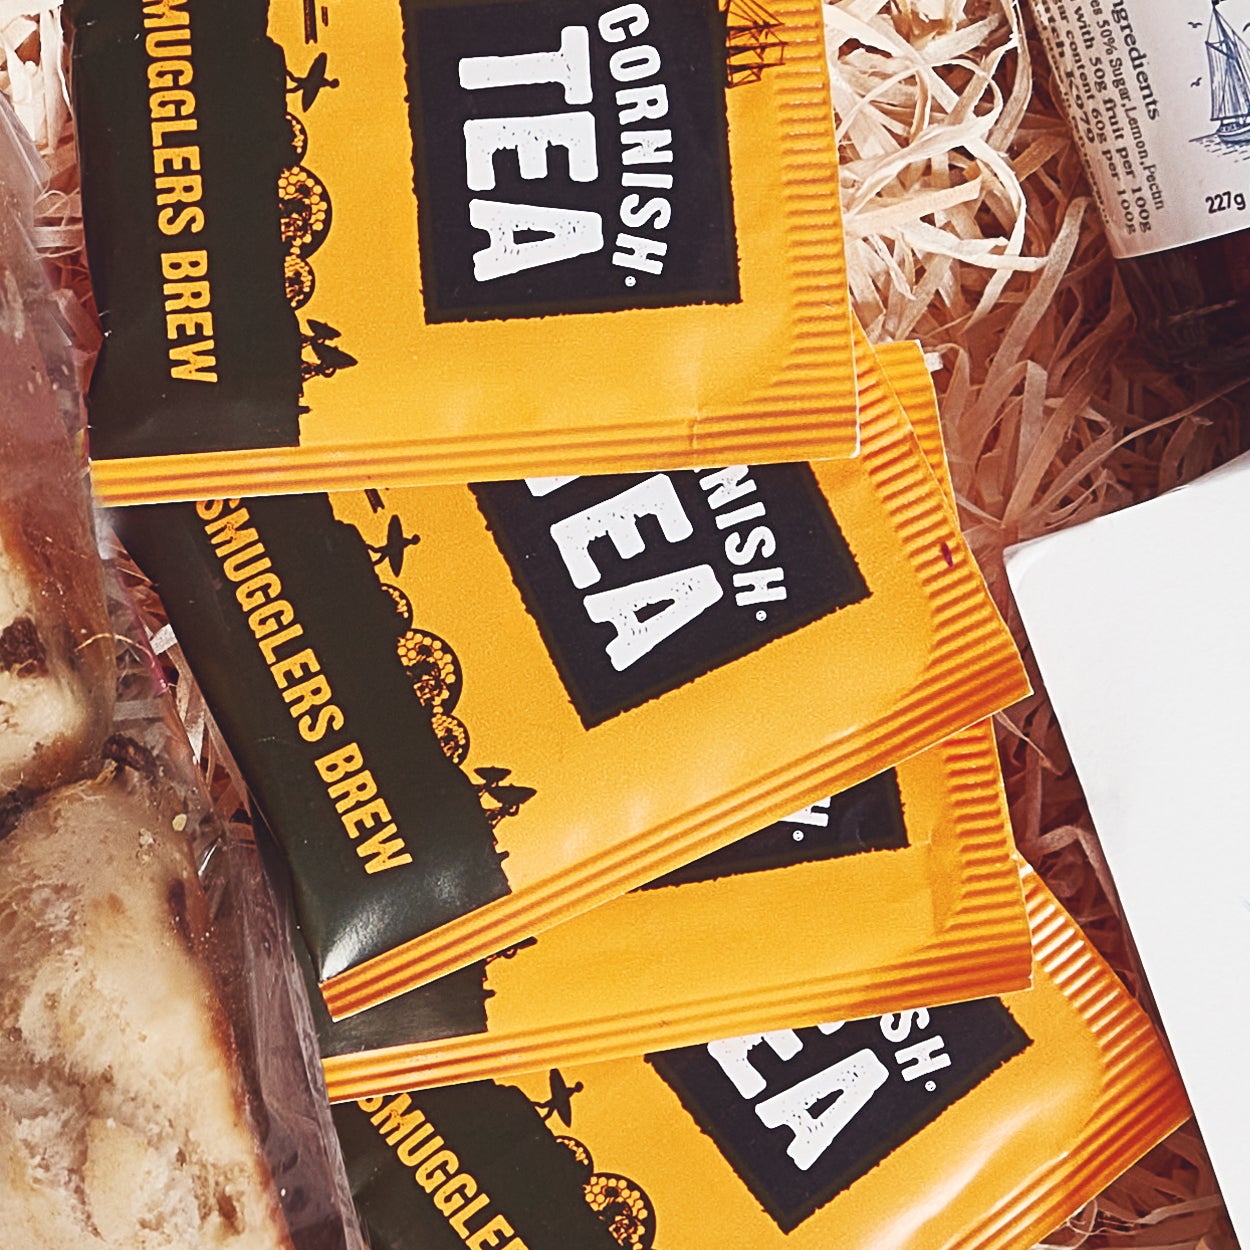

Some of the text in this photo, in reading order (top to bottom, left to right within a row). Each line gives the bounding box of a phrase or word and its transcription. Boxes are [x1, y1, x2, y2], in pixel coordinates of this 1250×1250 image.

[1096, 19, 1118, 56] 50%
[458, 25, 604, 282] TEA
[1065, 30, 1096, 101] content
[1091, 107, 1108, 145] 60g
[1102, 149, 1121, 182] per
[1117, 189, 1137, 236] 100g
[1074, 6, 1152, 234] with 50g fruit per 100g
[1205, 191, 1247, 214] 227g
[160, 249, 218, 385] BREW
[525, 473, 723, 671] EA
[697, 465, 787, 607] NISH
[312, 742, 414, 877] BREW
